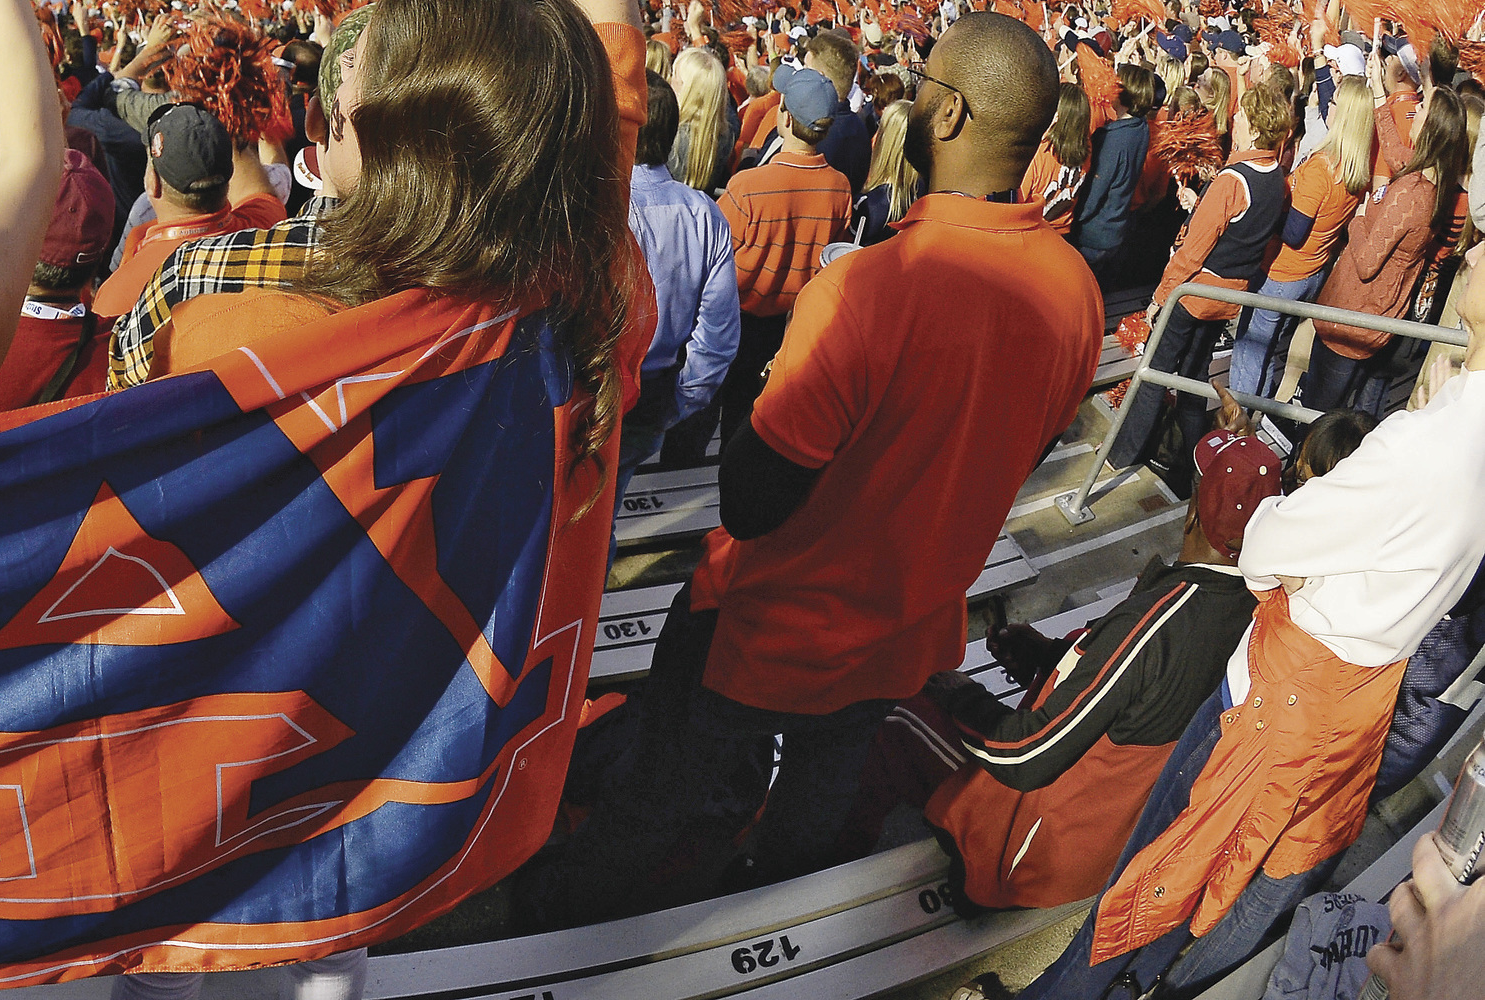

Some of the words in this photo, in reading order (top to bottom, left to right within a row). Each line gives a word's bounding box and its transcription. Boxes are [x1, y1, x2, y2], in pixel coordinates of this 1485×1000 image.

[623, 496, 664, 511] 130
[603, 620, 652, 640] 130
[730, 935, 802, 975] 129
